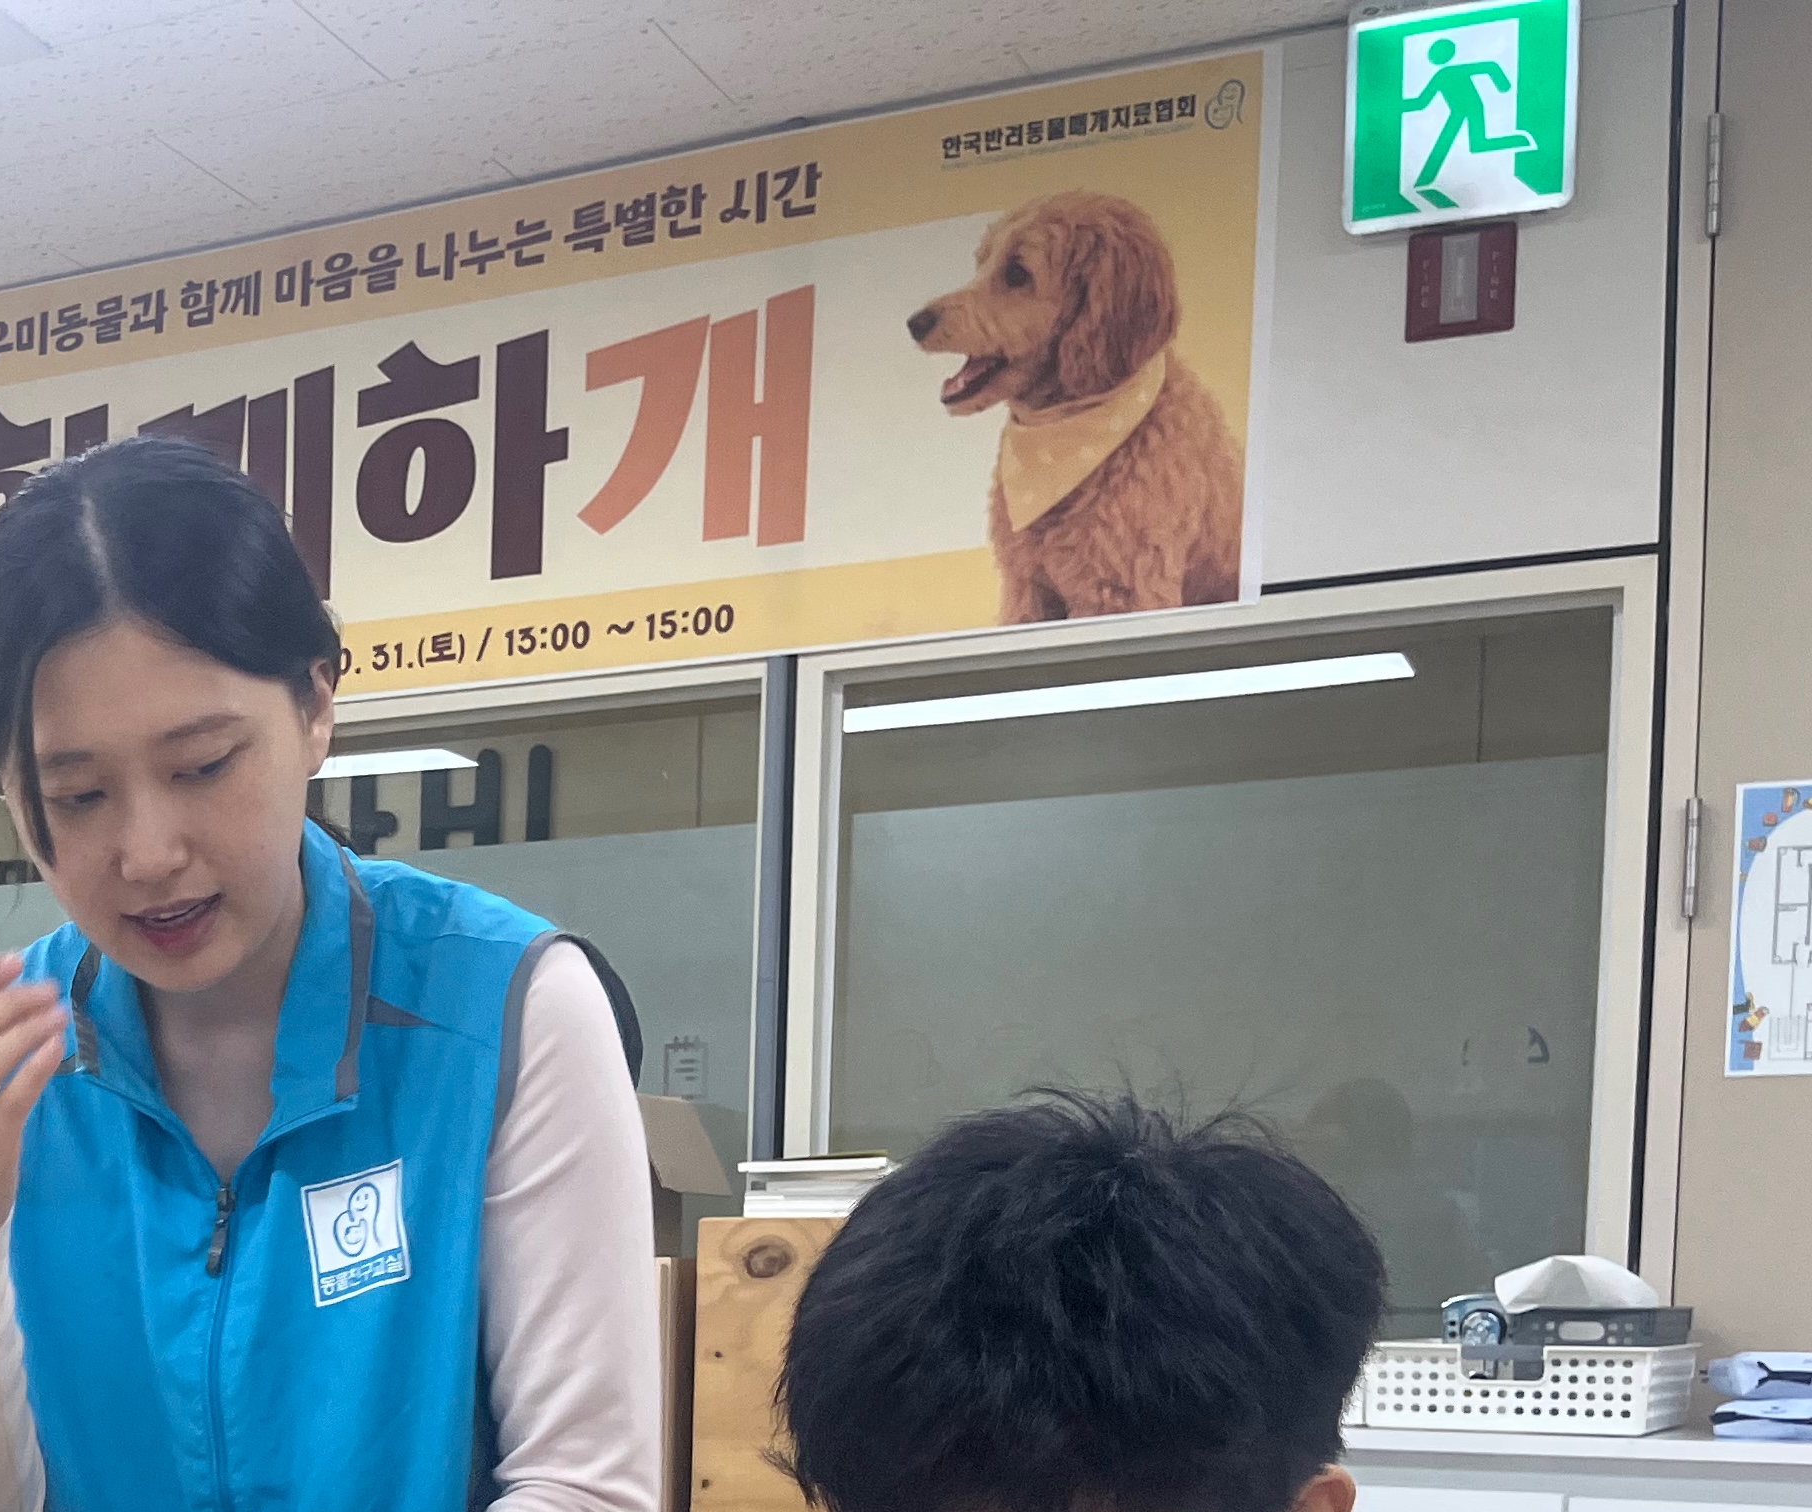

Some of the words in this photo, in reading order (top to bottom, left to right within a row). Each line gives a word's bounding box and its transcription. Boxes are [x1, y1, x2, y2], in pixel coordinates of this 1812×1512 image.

[181, 270, 262, 328] 함께
[275, 242, 403, 307] 마음을
[415, 218, 552, 281] 나누는
[564, 183, 707, 253] 특별한
[719, 162, 823, 224] 시간
[371, 631, 465, 673] 31.(토)
[504, 620, 589, 657] 13:00
[645, 604, 735, 641] 15:00
